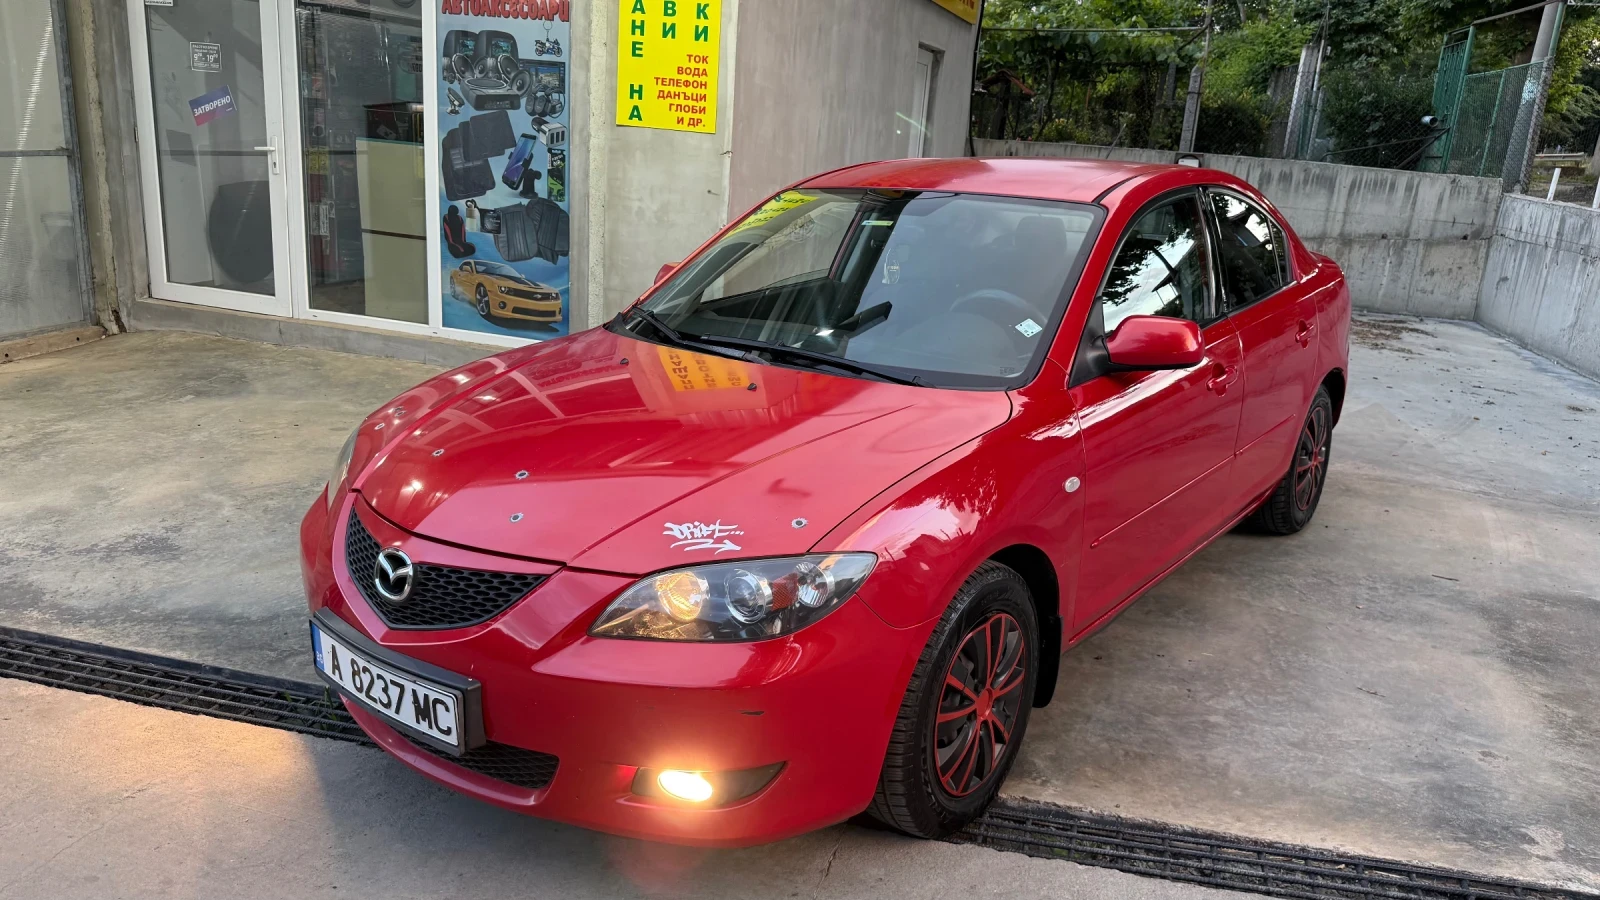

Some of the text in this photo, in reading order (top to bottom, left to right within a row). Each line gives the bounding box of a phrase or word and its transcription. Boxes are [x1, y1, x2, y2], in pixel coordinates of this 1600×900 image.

[686, 54, 709, 64] ТОК
[677, 66, 708, 78] ВОДА
[654, 76, 707, 89] ТЕЛЕФОН
[657, 90, 707, 103] ДАНЪЦИ
[193, 95, 231, 117] ЗАТВОРЕНО
[669, 103, 706, 115] ГЛОБИ
[676, 116, 706, 128] И ДР.
[331, 643, 453, 737] A 8237 MC
